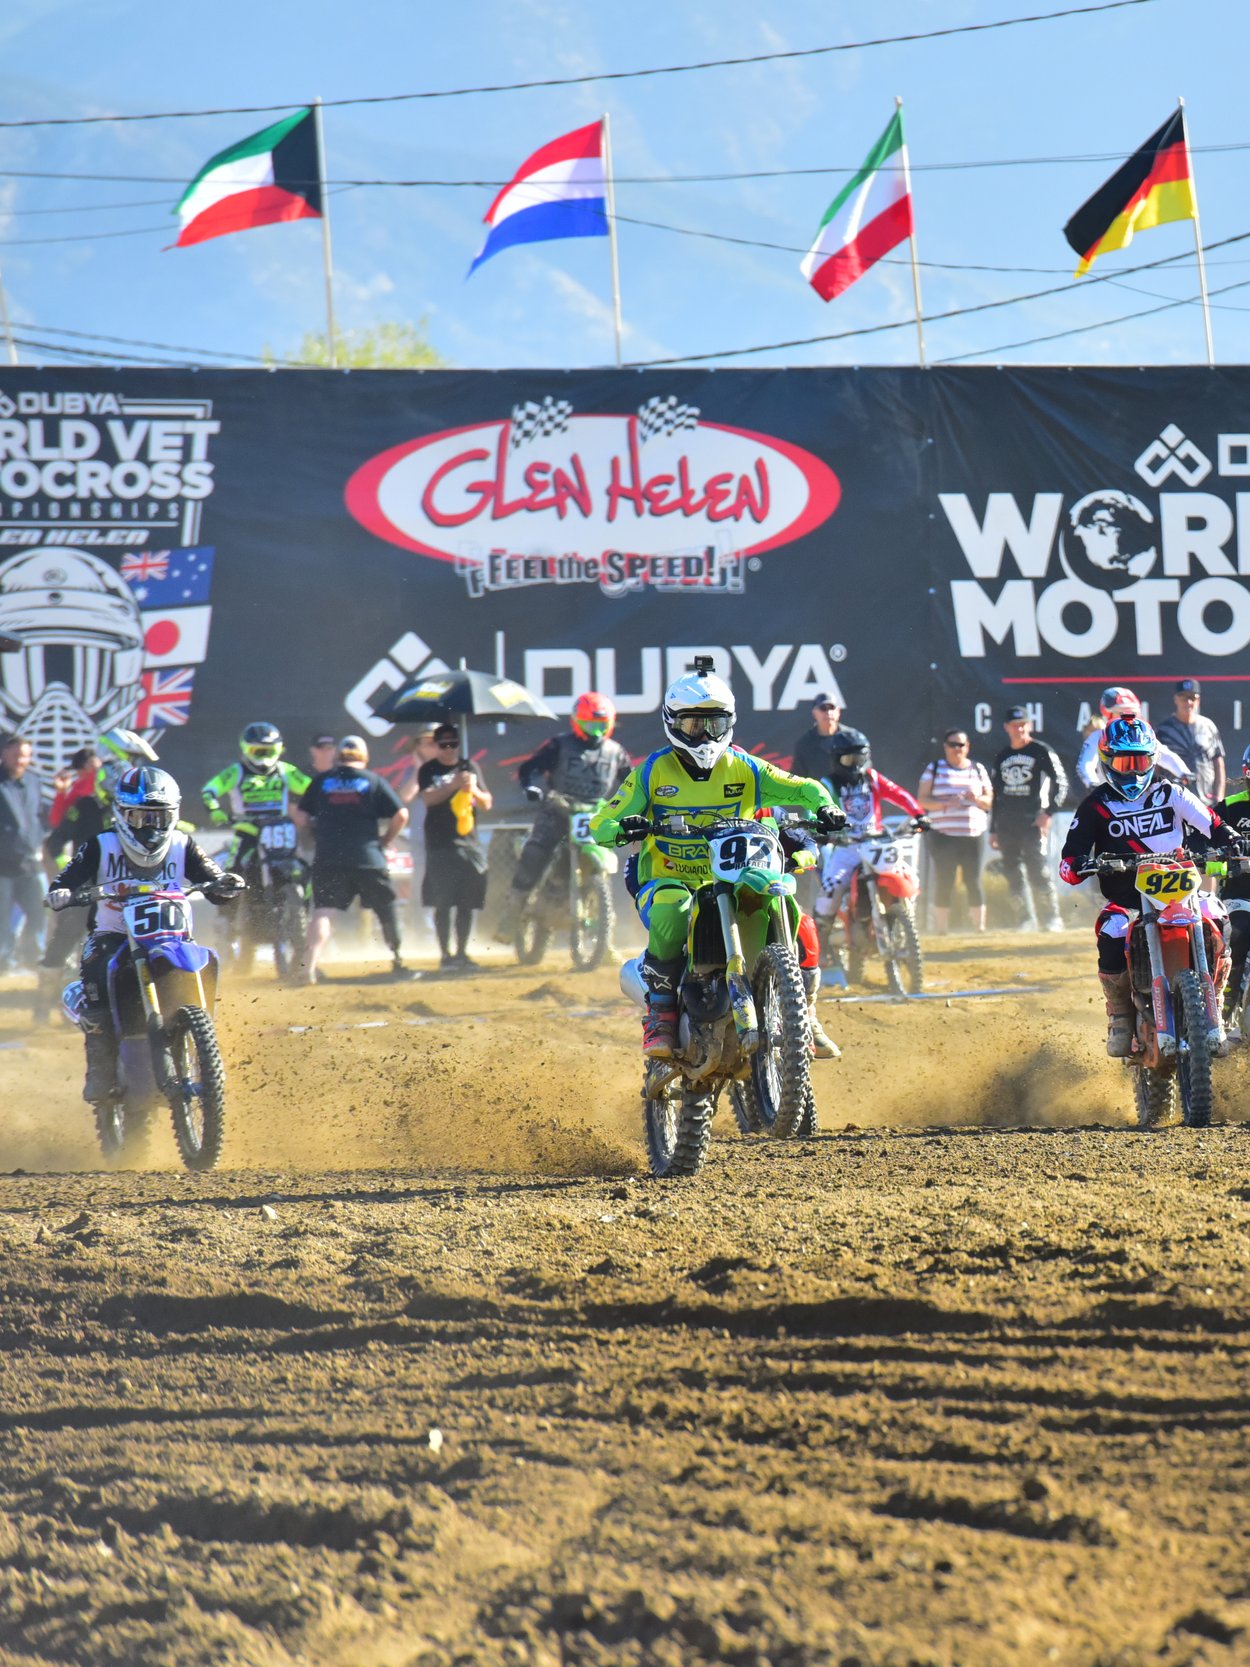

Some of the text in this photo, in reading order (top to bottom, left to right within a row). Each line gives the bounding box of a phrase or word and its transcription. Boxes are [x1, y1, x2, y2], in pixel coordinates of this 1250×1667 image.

[18, 392, 120, 415] DUBYA
[0, 418, 221, 462] RLD VET
[0, 460, 215, 500] OCROSS
[421, 416, 770, 528] GLEN HELEN
[12, 501, 179, 519] PIONSHIPS
[44, 529, 150, 545] HELEN
[557, 552, 599, 580] the
[260, 822, 296, 849] 469
[668, 844, 711, 859] BRA
[719, 836, 774, 871] 92
[869, 846, 899, 865] 73
[1145, 870, 1196, 895] 926
[134, 901, 184, 936] 50
